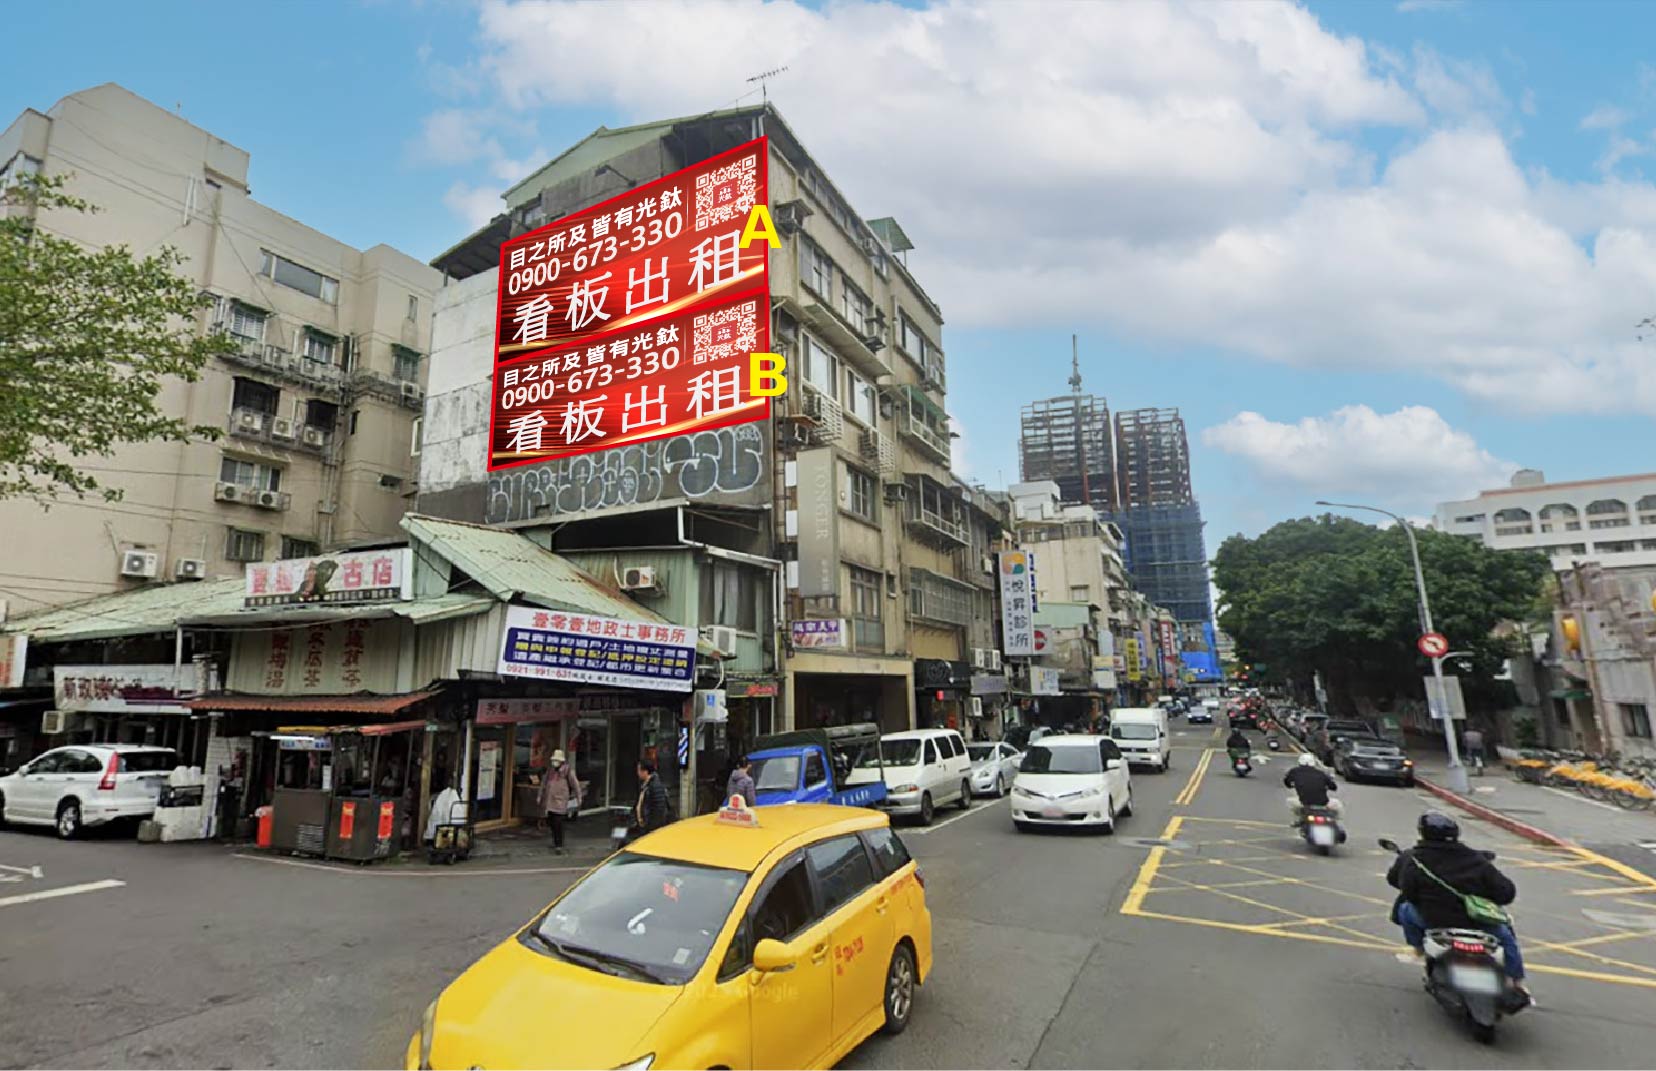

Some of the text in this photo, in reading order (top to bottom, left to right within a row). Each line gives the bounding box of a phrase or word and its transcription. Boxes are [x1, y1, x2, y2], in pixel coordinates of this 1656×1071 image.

[508, 211, 683, 295] 0900-673-330
[510, 185, 683, 271] 目之所及皆有光鈦
[512, 228, 746, 346] 看板出租
[501, 346, 680, 410] 0900-673-330
[503, 323, 680, 387] 目之所及皆有光鈦
[505, 364, 746, 455] 看板出租
[532, 611, 686, 644] 壹零壹地政士事務所
